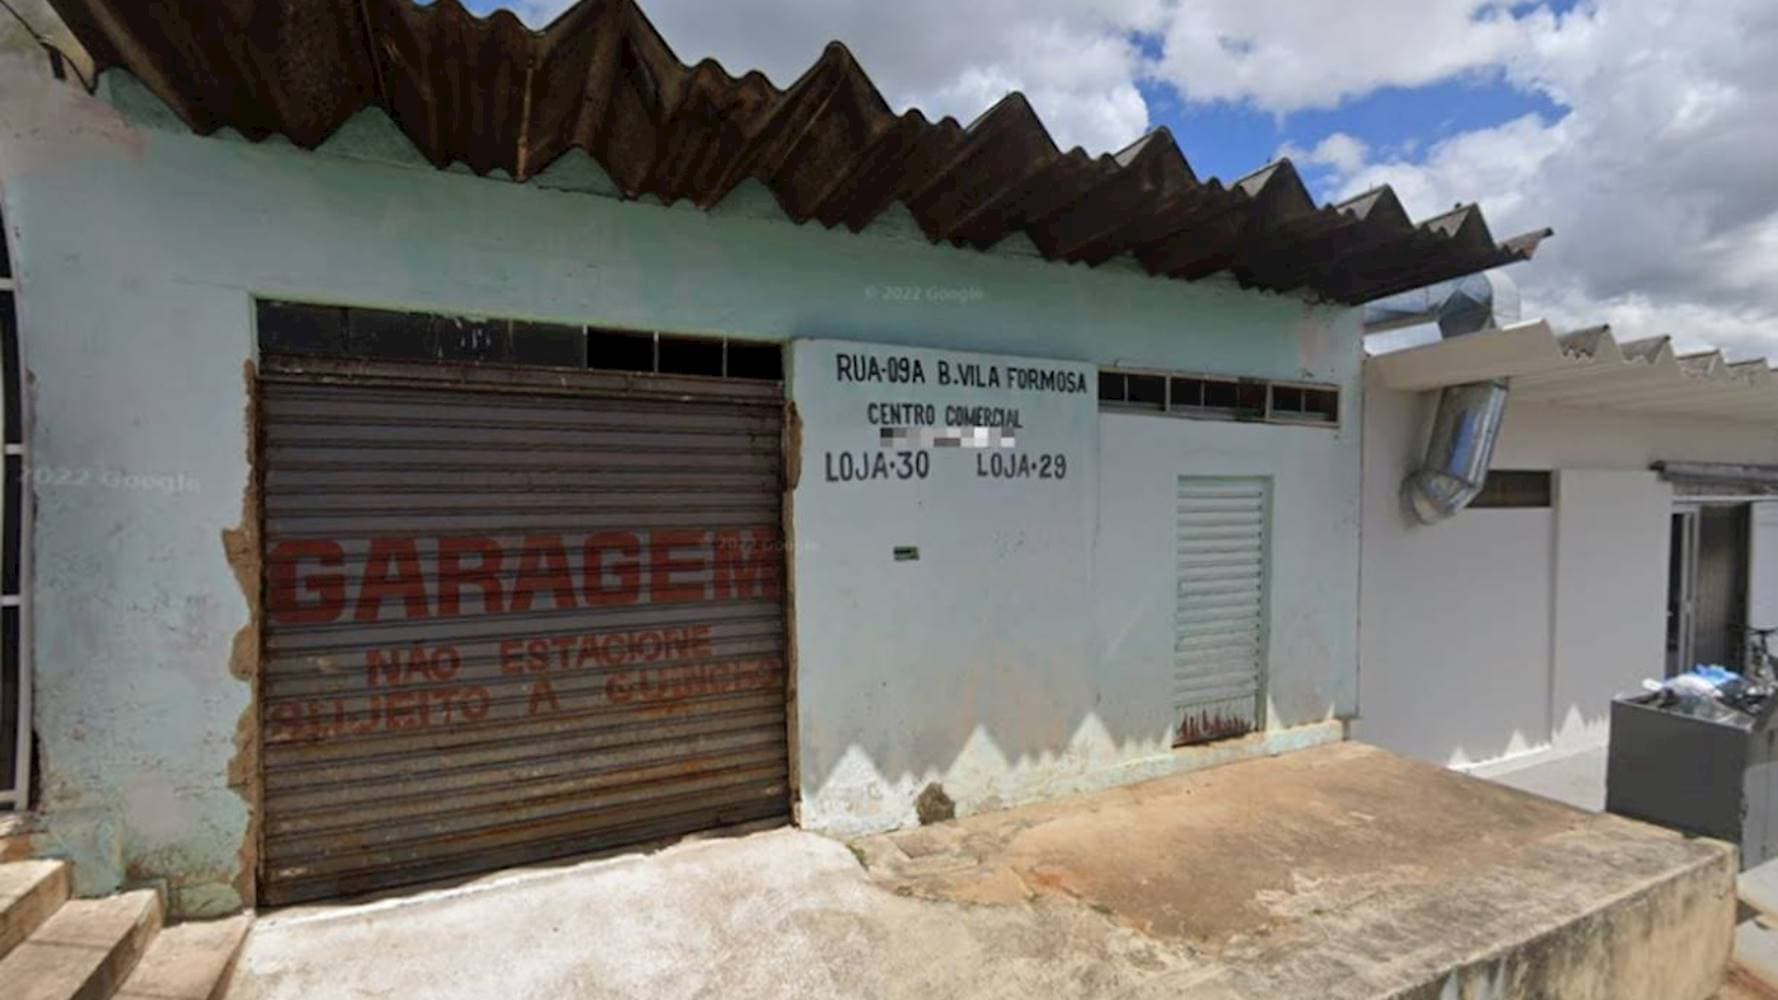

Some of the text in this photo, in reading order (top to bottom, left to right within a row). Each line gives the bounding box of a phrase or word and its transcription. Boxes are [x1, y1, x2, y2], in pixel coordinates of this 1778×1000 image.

[938, 361, 1000, 388] B.VILA
[1007, 367, 1087, 393] FORMOSA
[868, 403, 1023, 429] CENTRO COMERCIAL
[269, 528, 778, 624] GARAGEM
[500, 625, 714, 675] ESTACIONE
